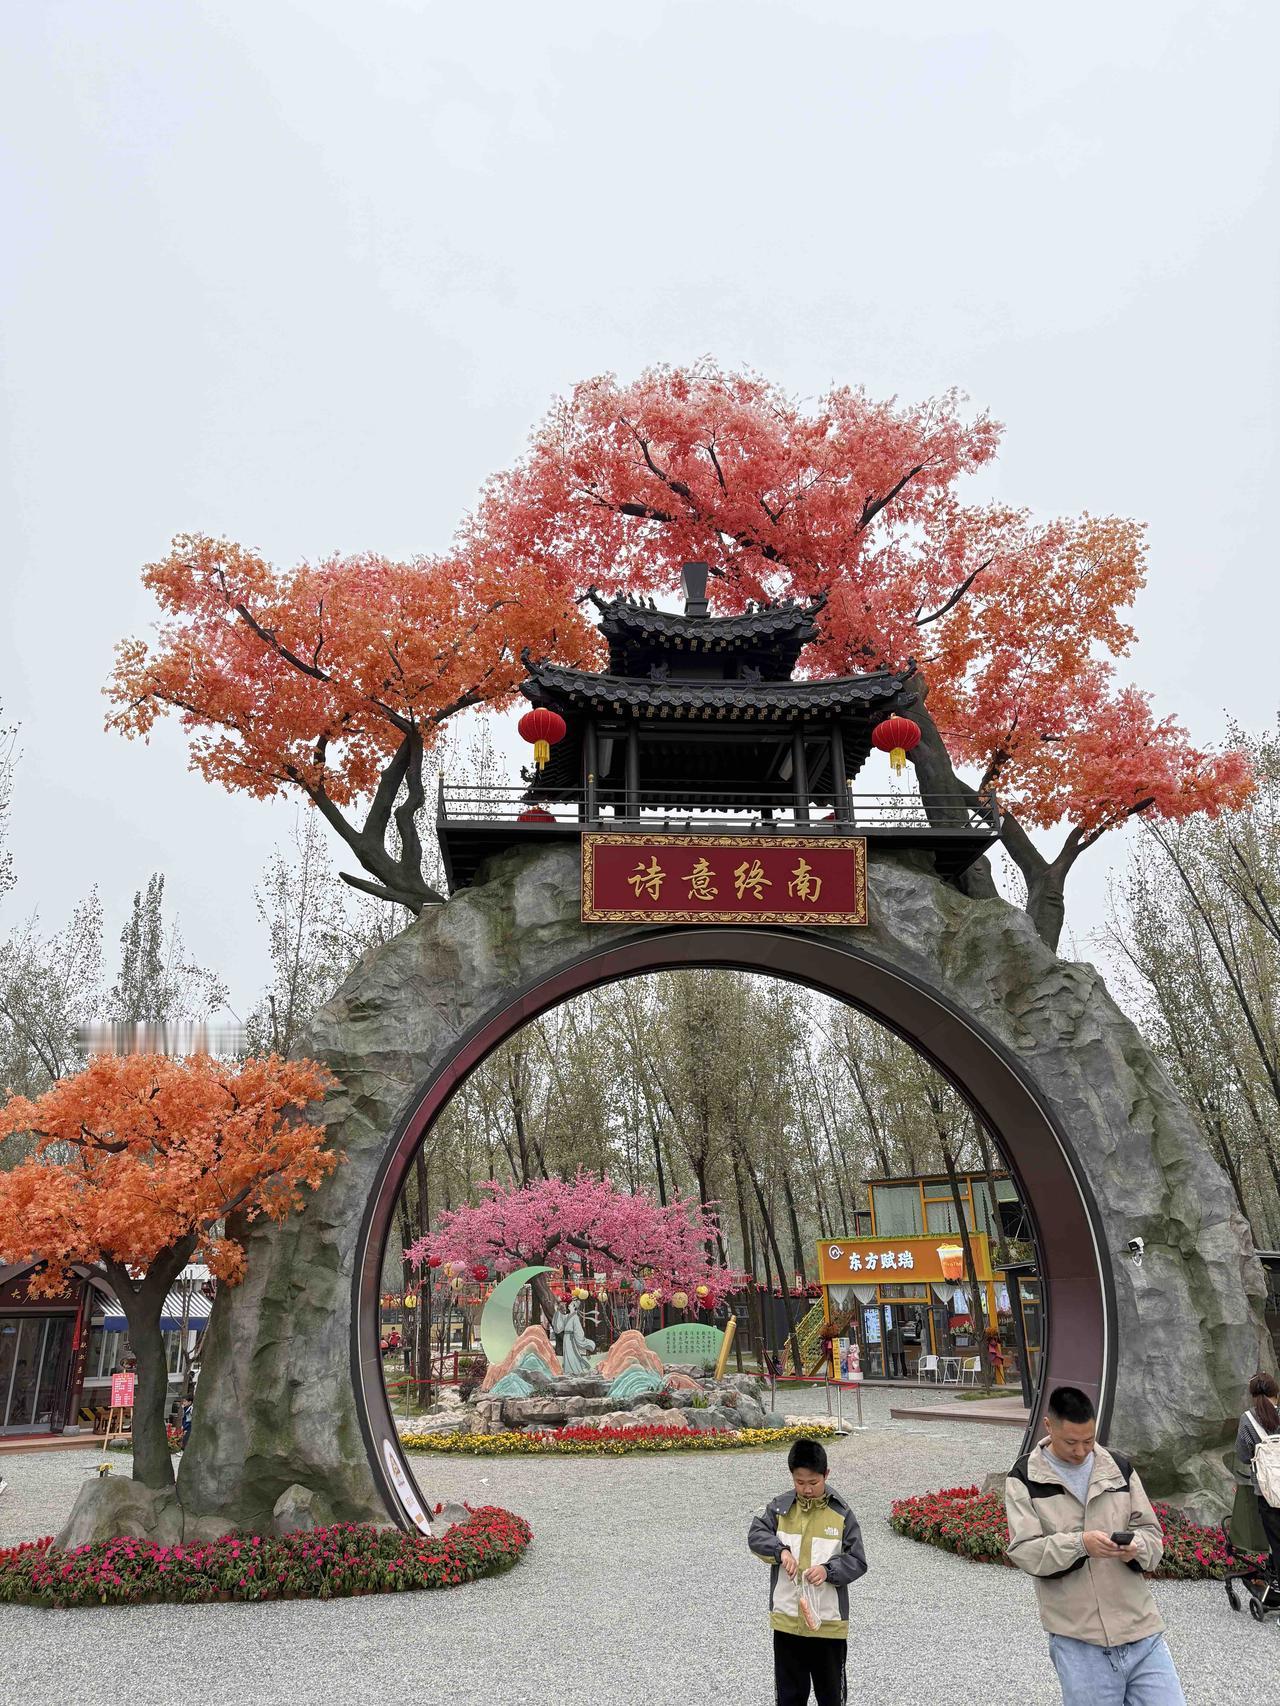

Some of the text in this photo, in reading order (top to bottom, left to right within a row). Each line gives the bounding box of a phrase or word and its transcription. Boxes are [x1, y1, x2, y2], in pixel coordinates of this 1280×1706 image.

[627, 855, 823, 903] 诗意终南
[848, 1250, 914, 1272] 东方赋瑞
